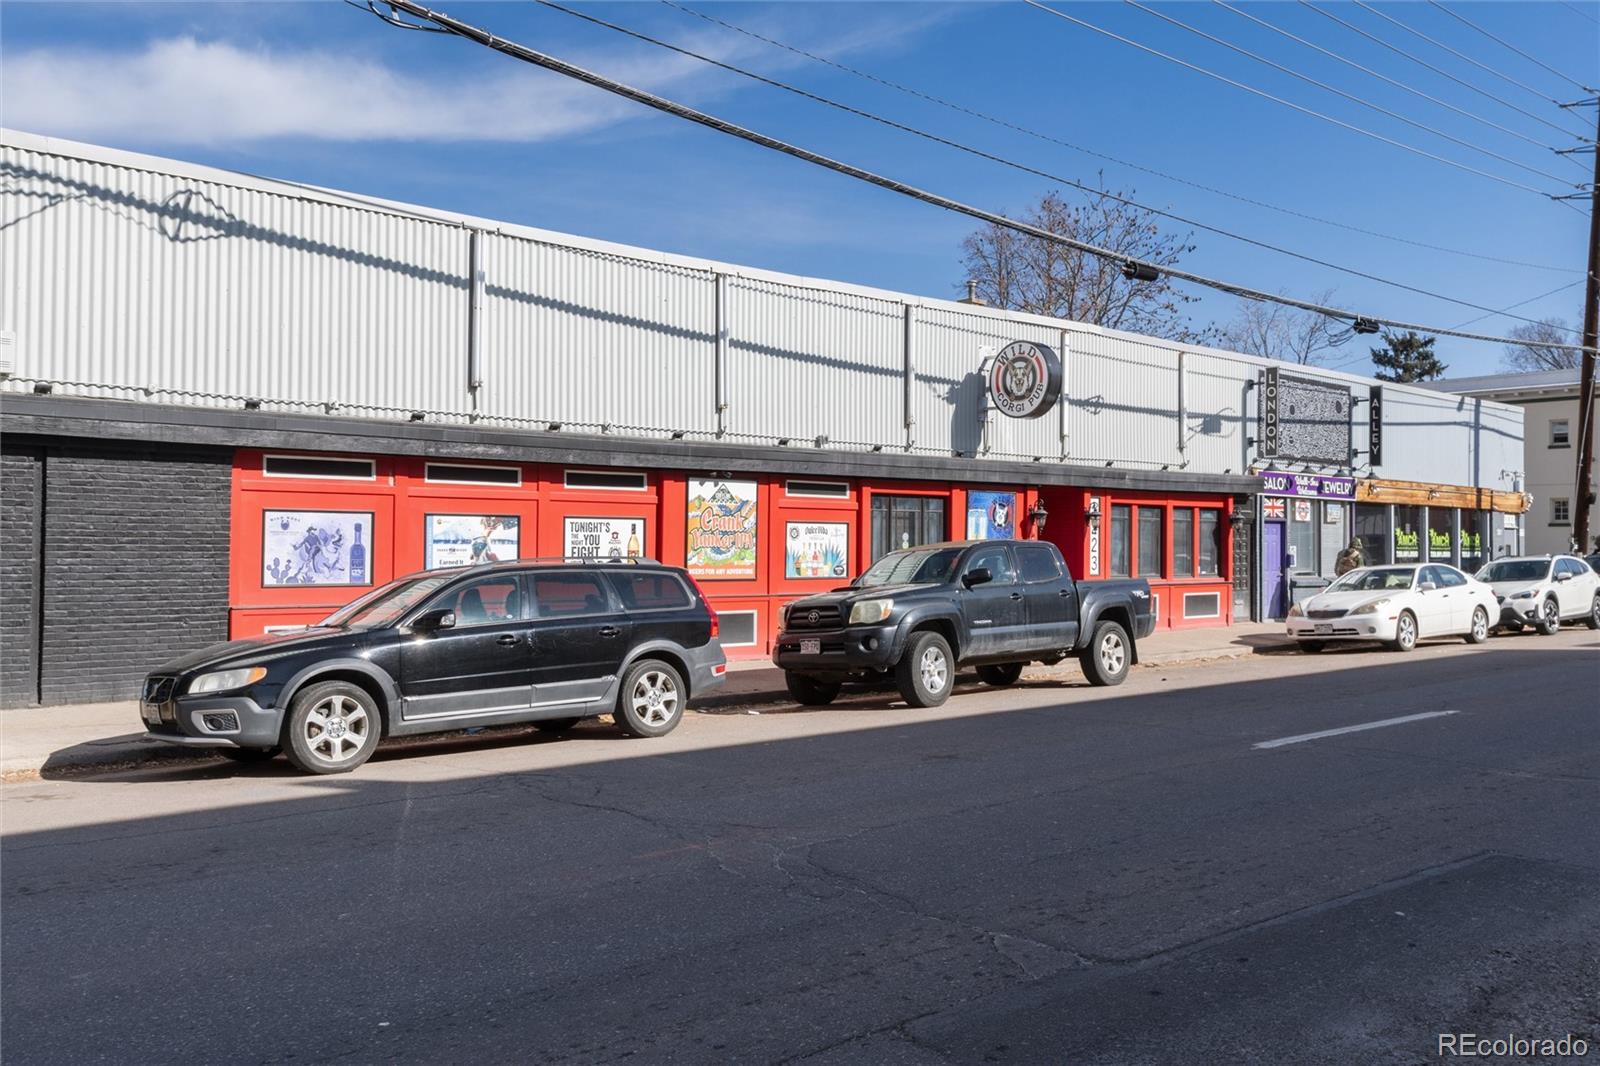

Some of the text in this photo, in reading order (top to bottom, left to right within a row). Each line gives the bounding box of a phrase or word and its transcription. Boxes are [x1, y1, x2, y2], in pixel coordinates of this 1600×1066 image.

[997, 344, 1037, 369] WILD
[997, 383, 1044, 412] CORGI PUB
[1266, 373, 1277, 450] LONDON
[1371, 398, 1380, 455] ALLEY
[570, 521, 610, 533] TONIGHT'S
[700, 506, 747, 533] Crank
[571, 546, 600, 558] FIGHT
[584, 534, 600, 546] YOU
[735, 531, 753, 549] IPA
